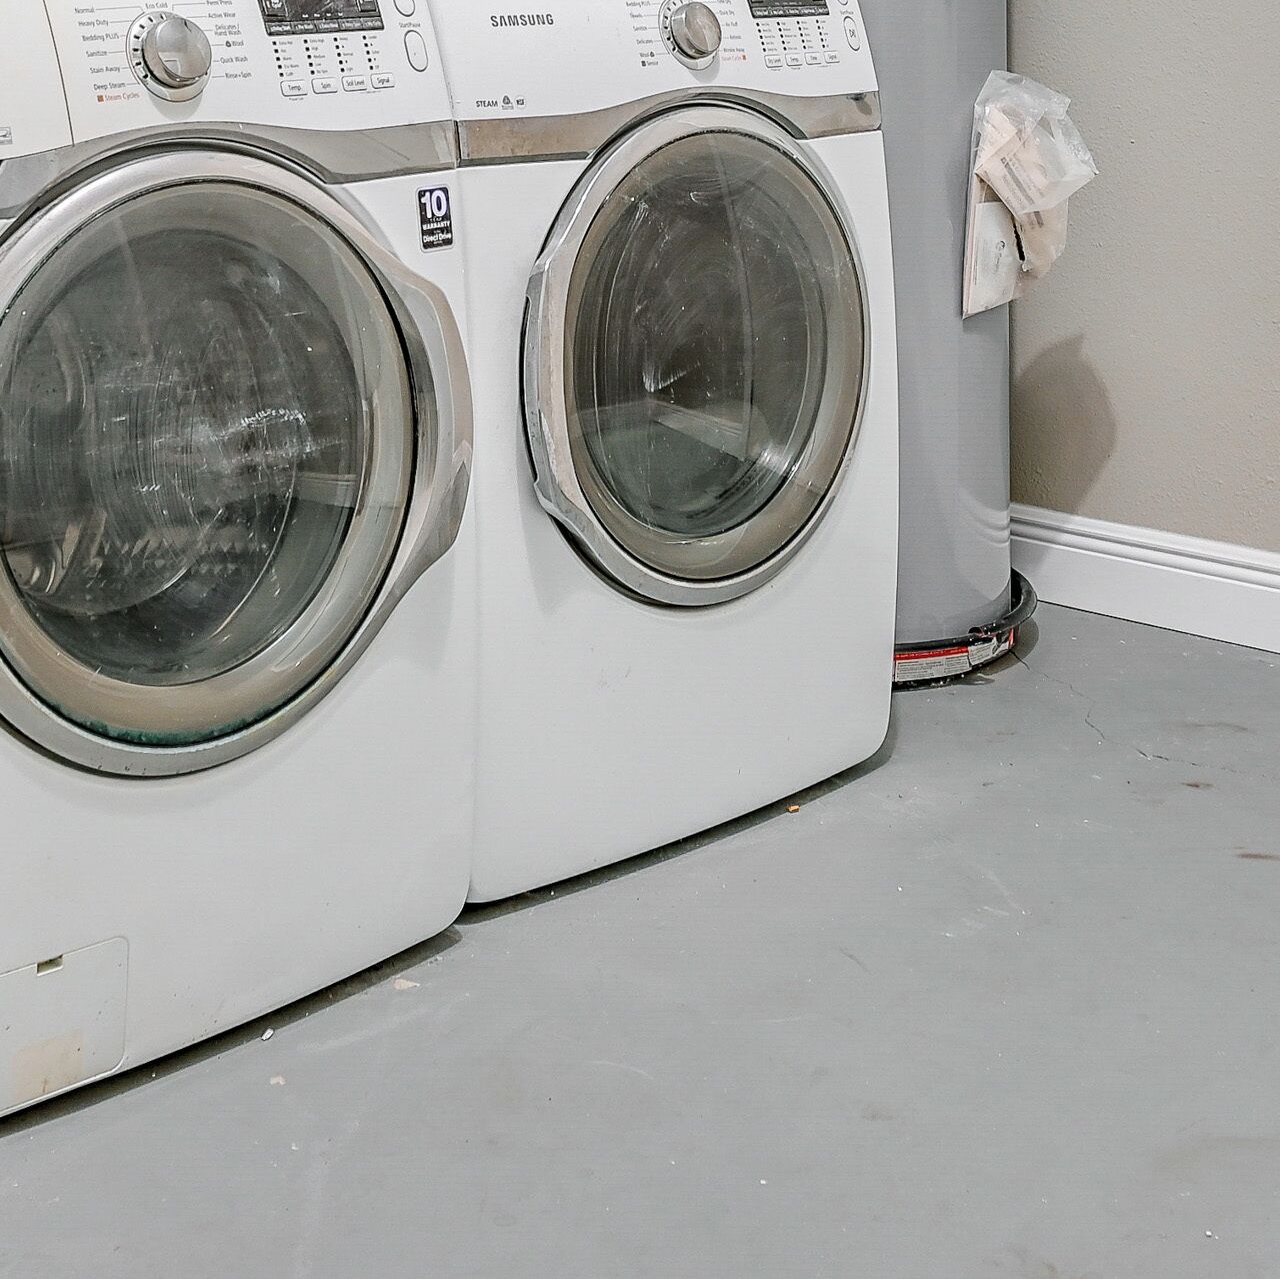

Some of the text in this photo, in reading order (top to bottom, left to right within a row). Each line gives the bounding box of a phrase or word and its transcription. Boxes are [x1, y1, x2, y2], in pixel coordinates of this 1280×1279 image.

[490, 14, 554, 28] SAMSUNG
[420, 189, 448, 219] 10
[422, 220, 450, 230] WARRANTY
